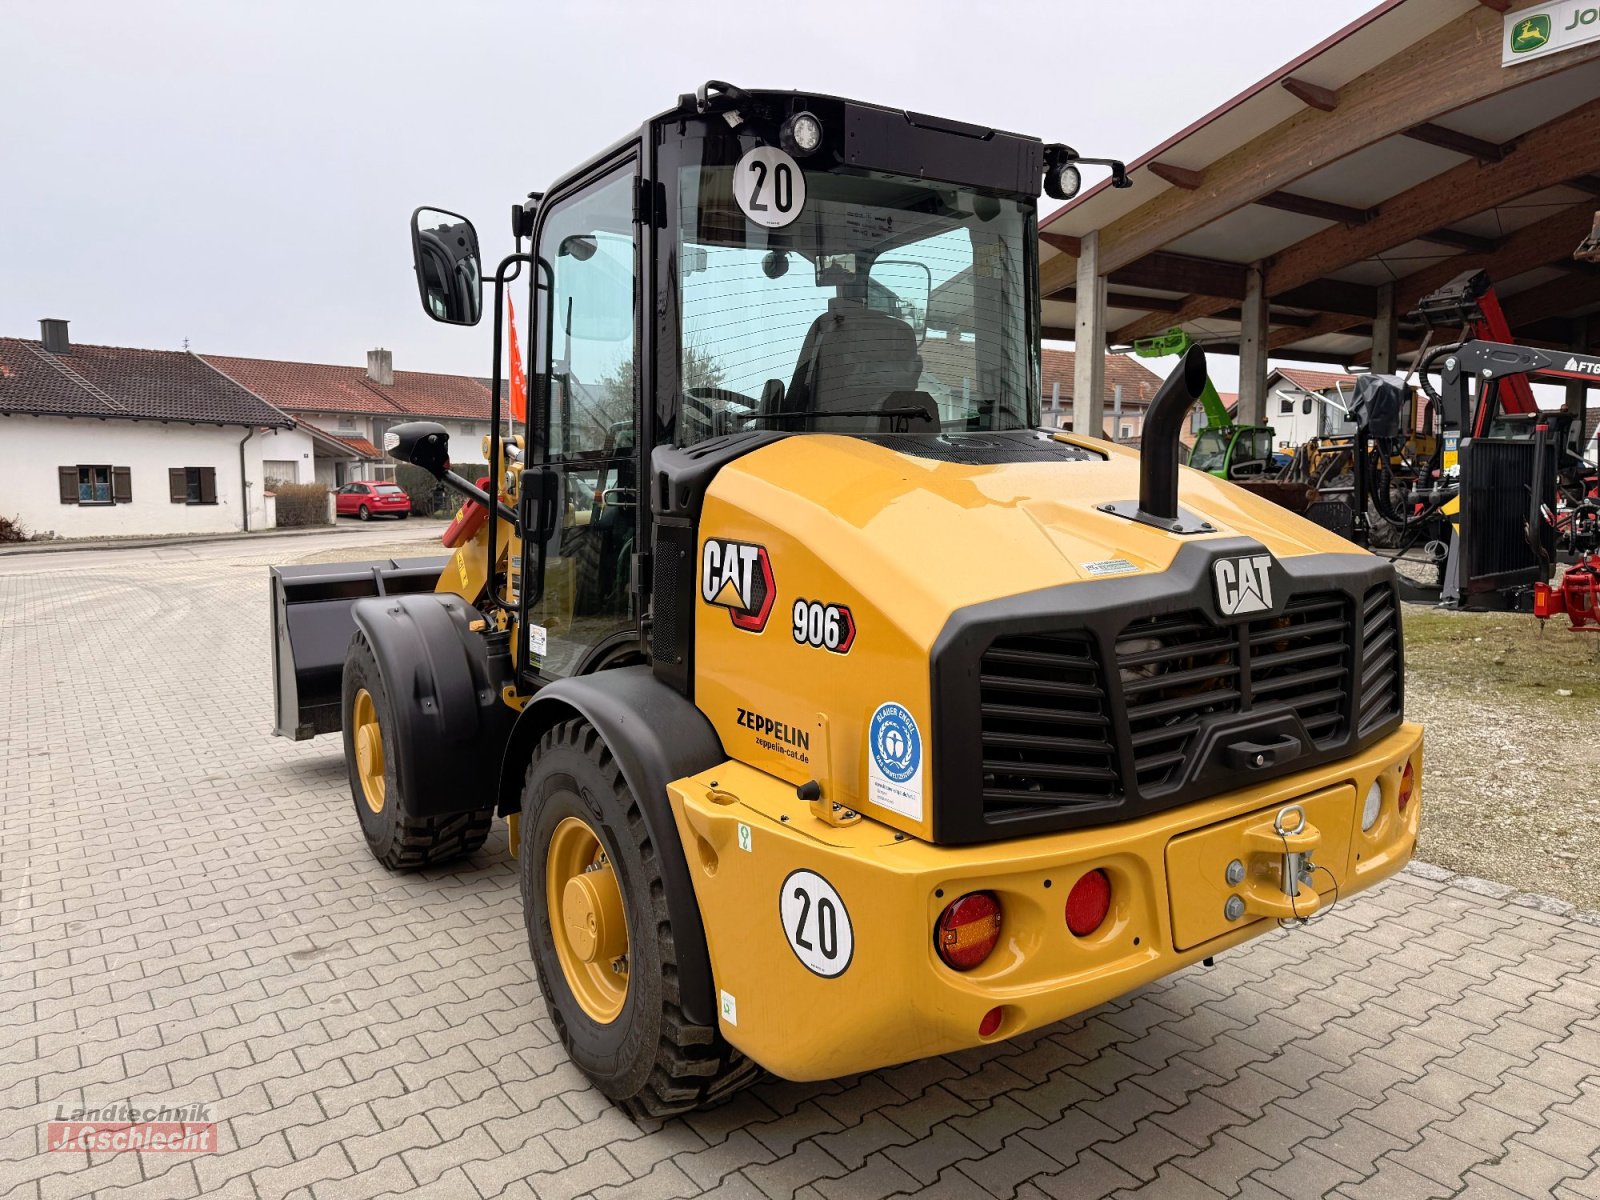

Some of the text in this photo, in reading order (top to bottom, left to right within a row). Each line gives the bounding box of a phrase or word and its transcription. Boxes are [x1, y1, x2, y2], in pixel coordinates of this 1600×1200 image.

[1565, 6, 1600, 31] JO
[749, 161, 793, 213] 20
[702, 540, 758, 610] CAT
[1215, 556, 1273, 615] CAT
[794, 601, 840, 649] 906
[737, 707, 809, 751] ZEPPELIN
[876, 707, 916, 736] BLAUER ENGEL
[755, 736, 809, 764] zeppelin-cat.de
[794, 887, 838, 960] 20
